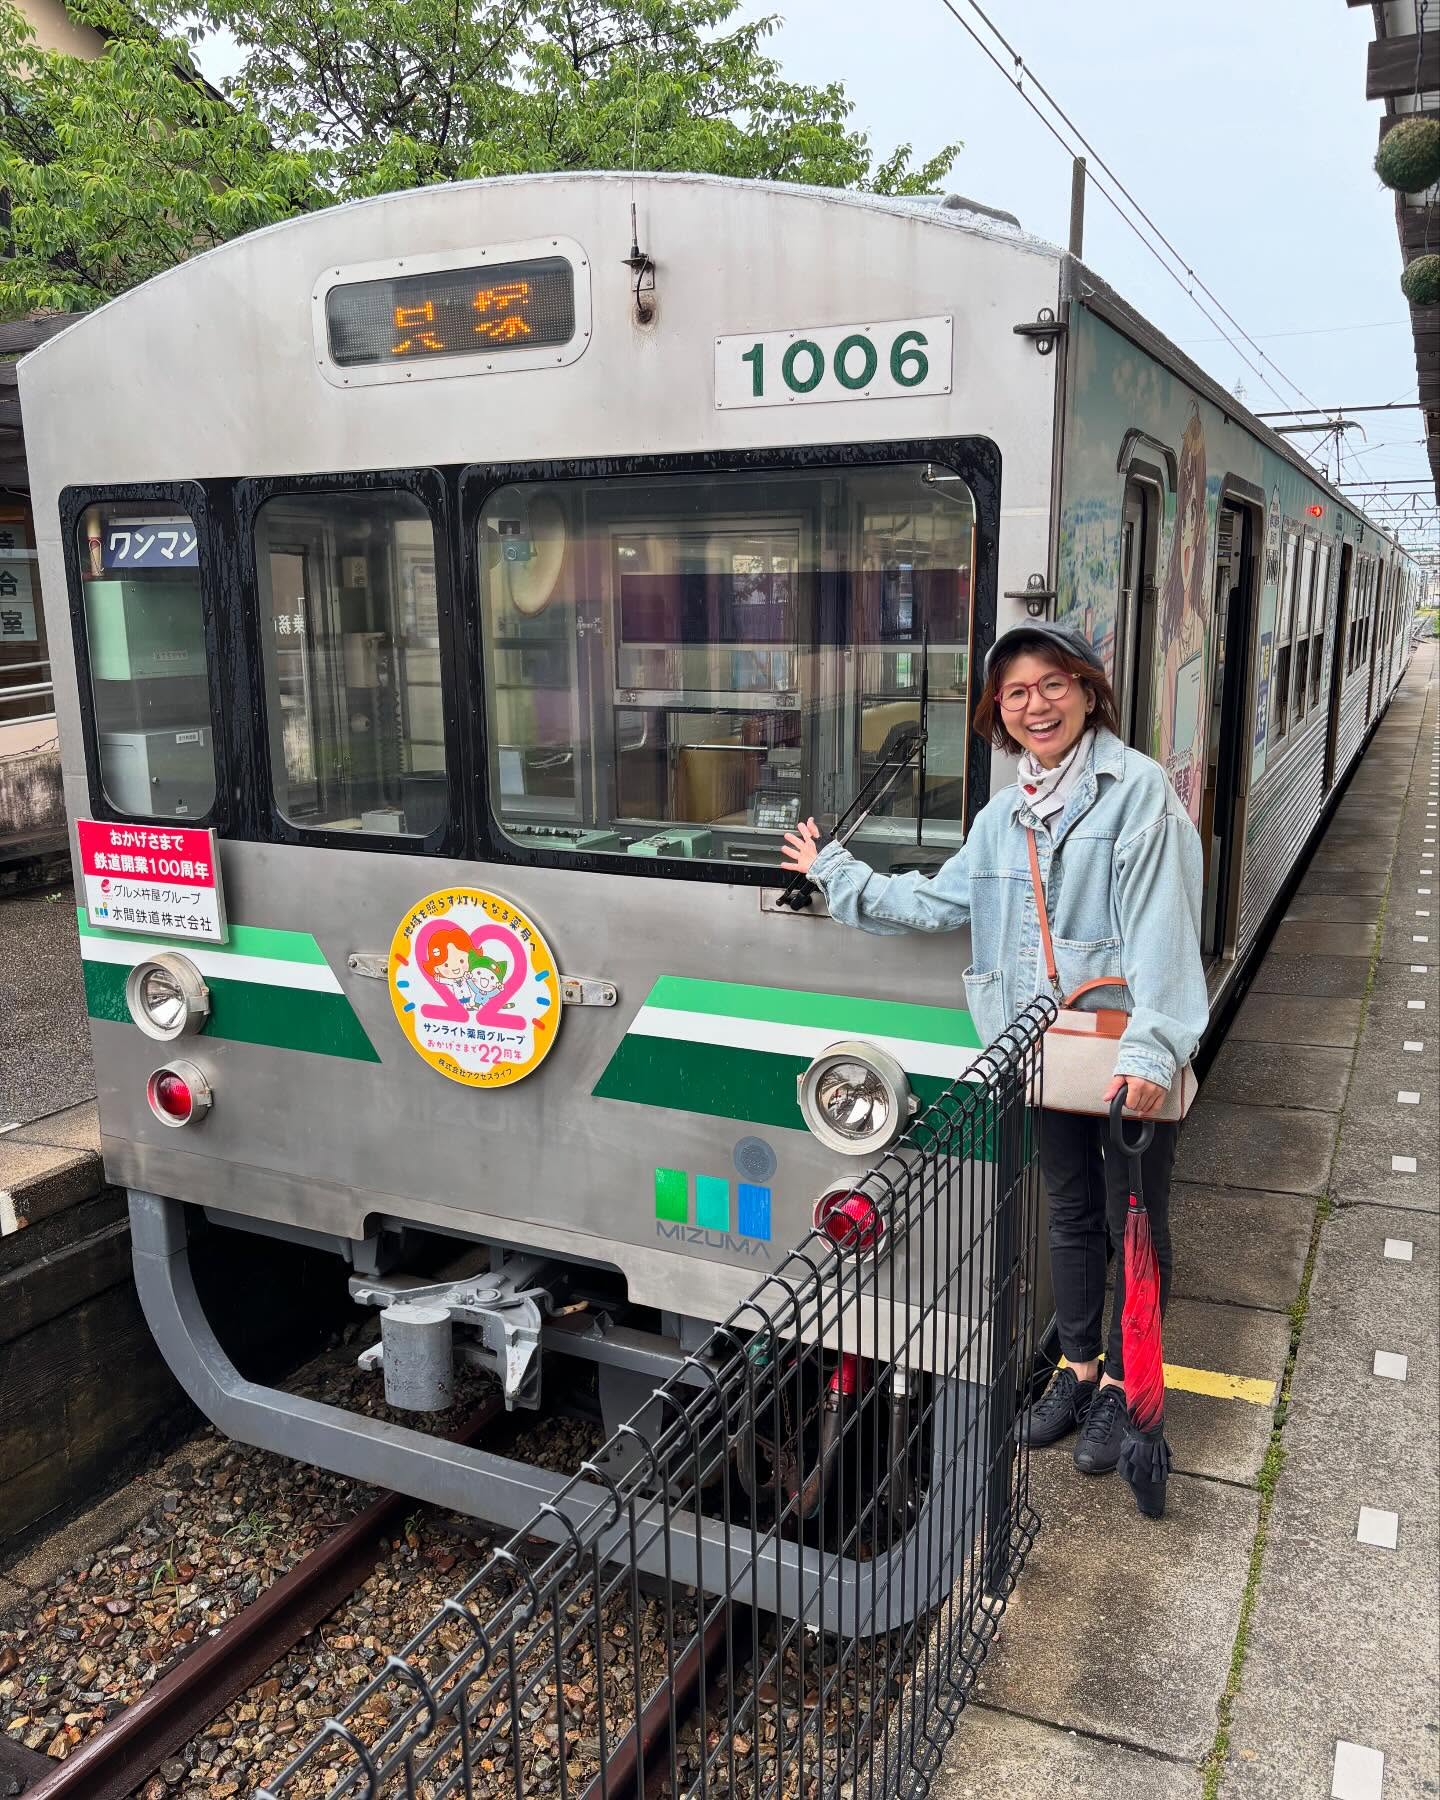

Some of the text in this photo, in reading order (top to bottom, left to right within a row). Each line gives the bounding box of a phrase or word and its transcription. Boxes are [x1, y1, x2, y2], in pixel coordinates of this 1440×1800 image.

[742, 330, 929, 397] 1006
[110, 531, 198, 560] ワンマン
[109, 829, 185, 851] おかげさまで
[93, 851, 210, 880] 鉄道開業100周年
[113, 884, 201, 905] グルメ杵屋グループ
[112, 906, 213, 932] 水間鉄道株式会社
[403, 894, 536, 952] 地域を照らす灯りとなる薬局へ
[423, 1022, 525, 1045] サンライト薬局グループ
[427, 1039, 523, 1065] おかげさまで22周年
[438, 1057, 512, 1081] 株式会社アクセスライフ
[655, 1220, 771, 1259] MIZUMA
